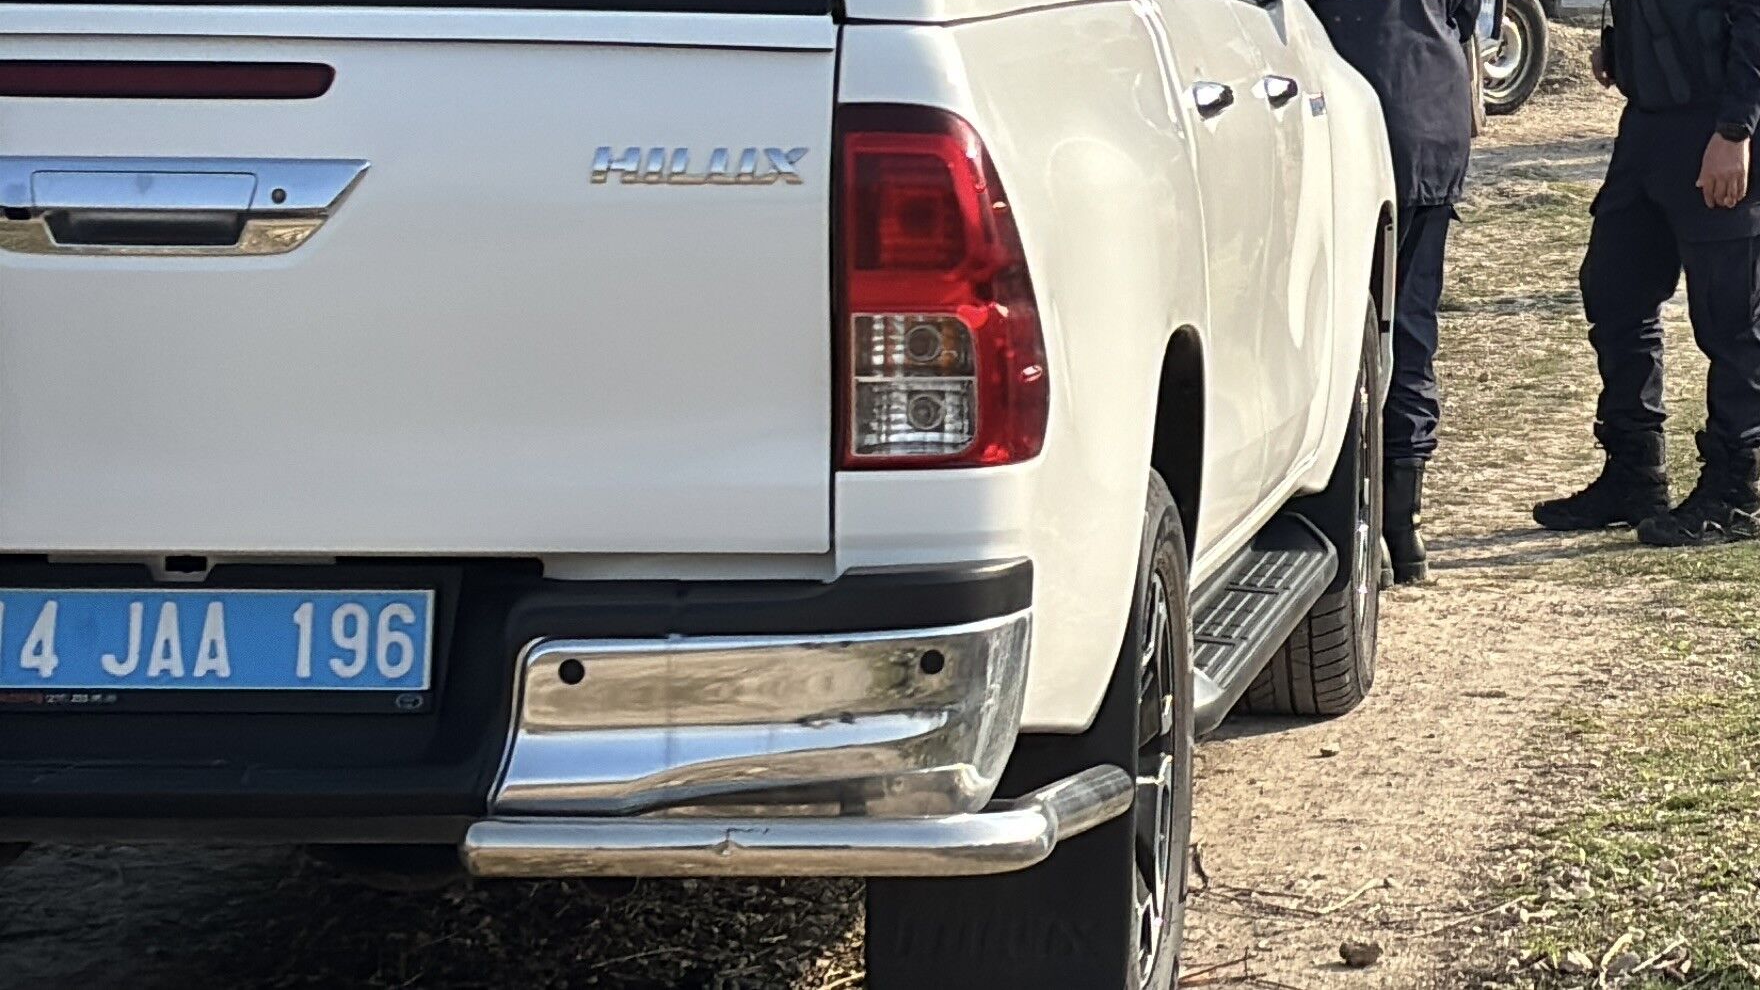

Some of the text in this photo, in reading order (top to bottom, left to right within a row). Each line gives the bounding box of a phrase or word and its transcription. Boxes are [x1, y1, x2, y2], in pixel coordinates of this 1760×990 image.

[591, 145, 810, 185] HILUX
[0, 600, 417, 679] 4 JAA 196
